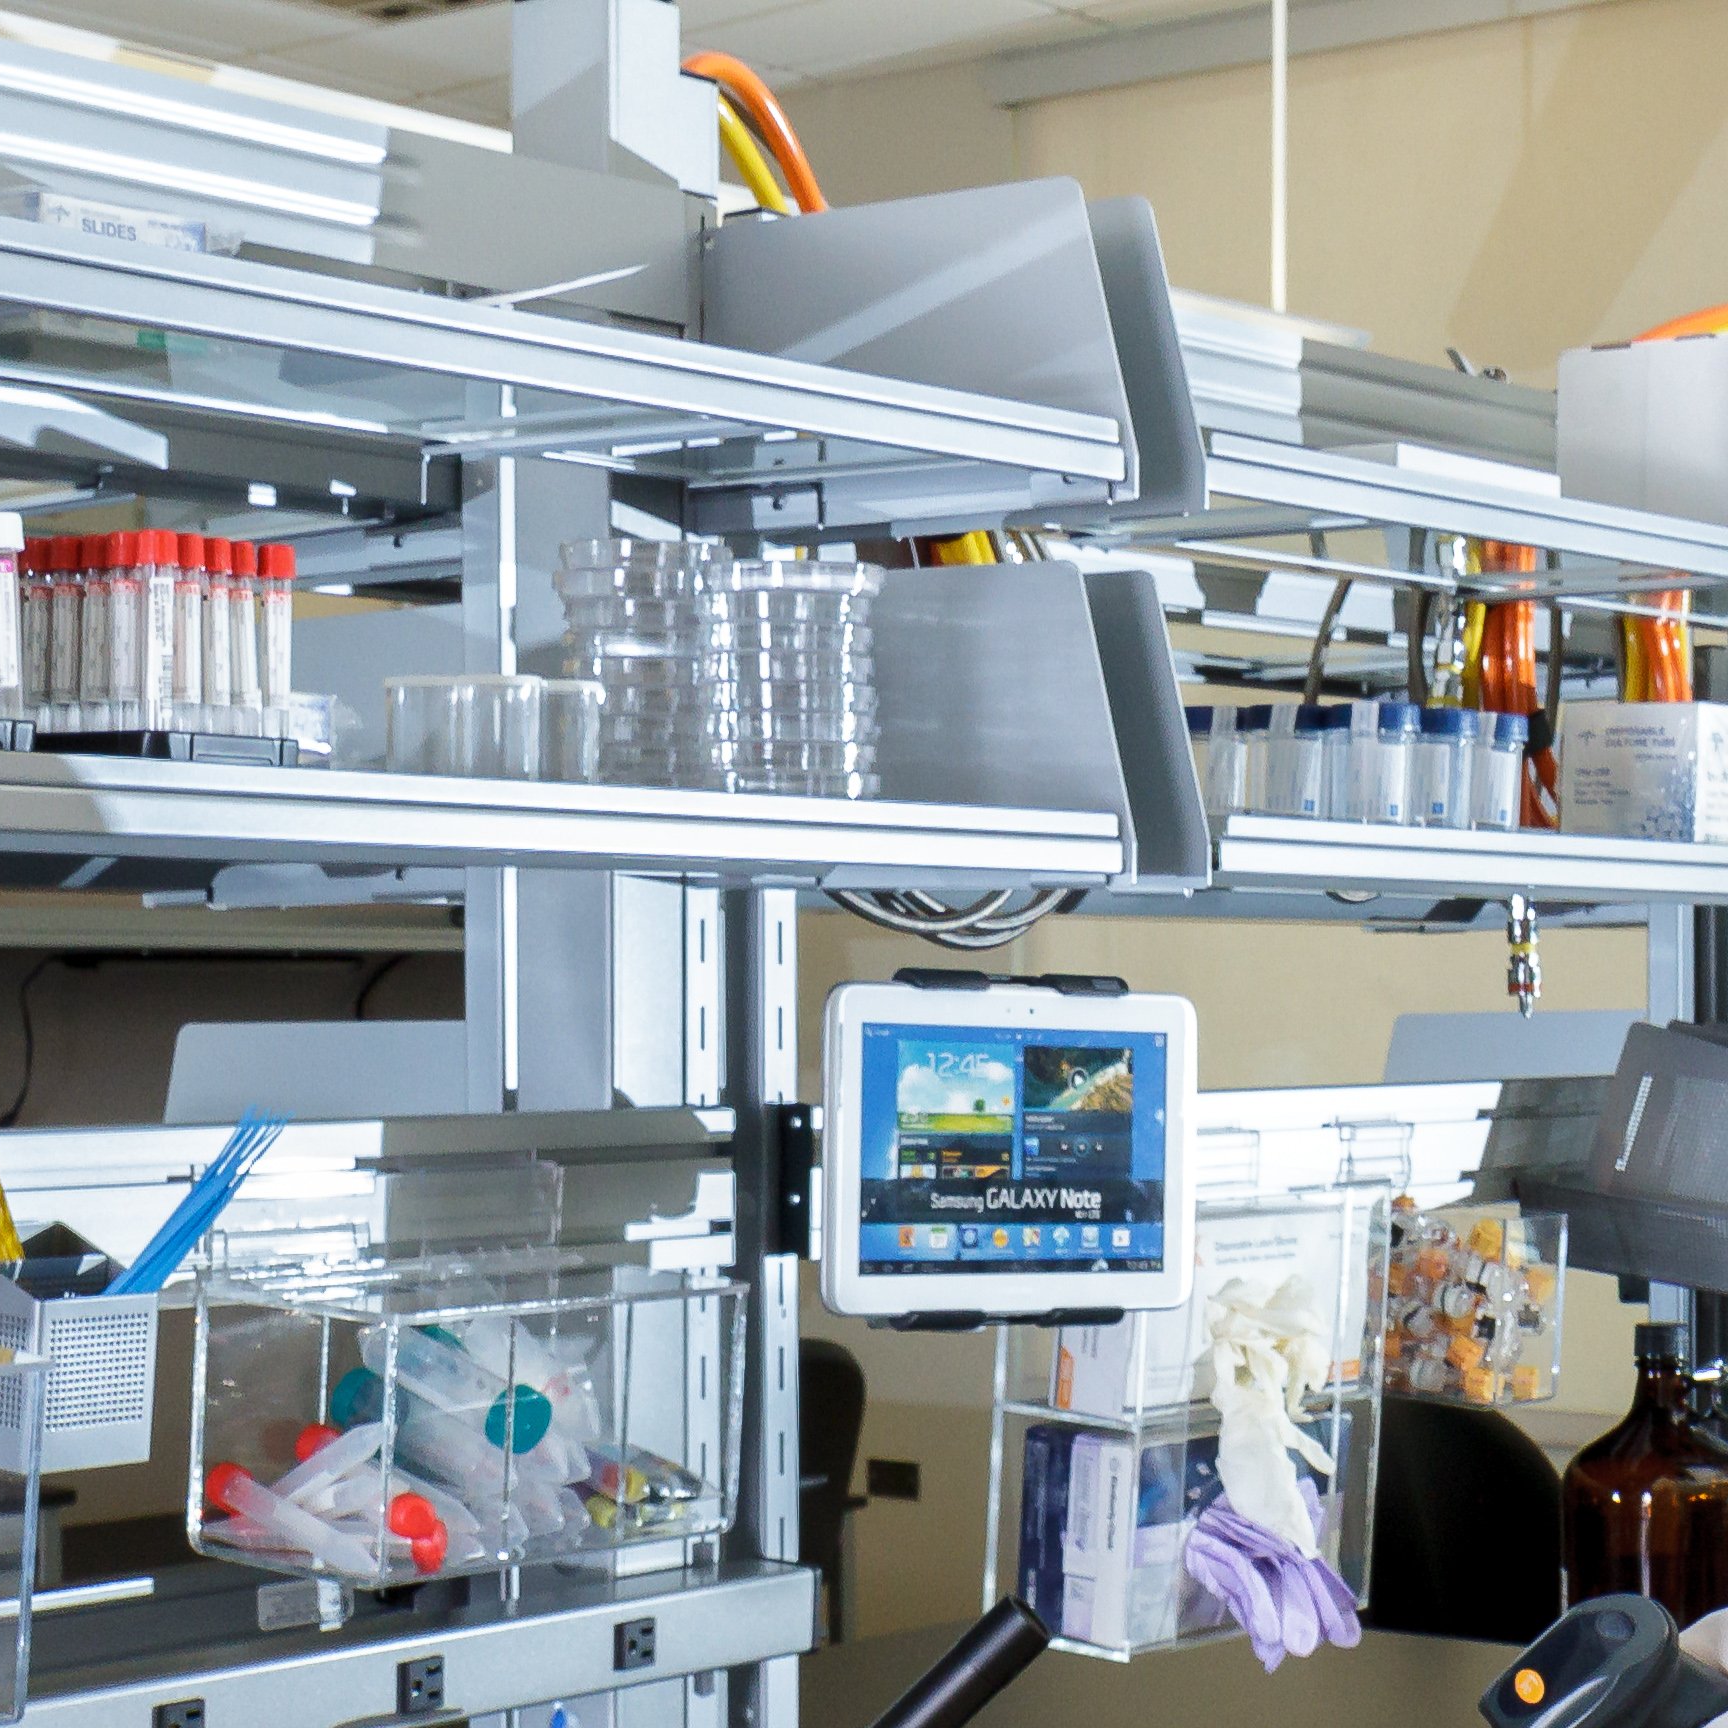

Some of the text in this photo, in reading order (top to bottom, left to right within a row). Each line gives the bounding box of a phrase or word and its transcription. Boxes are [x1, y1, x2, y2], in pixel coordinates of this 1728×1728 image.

[81, 217, 137, 242] SLIDES
[930, 1187, 1102, 1213] Samsung GALAXY Note
